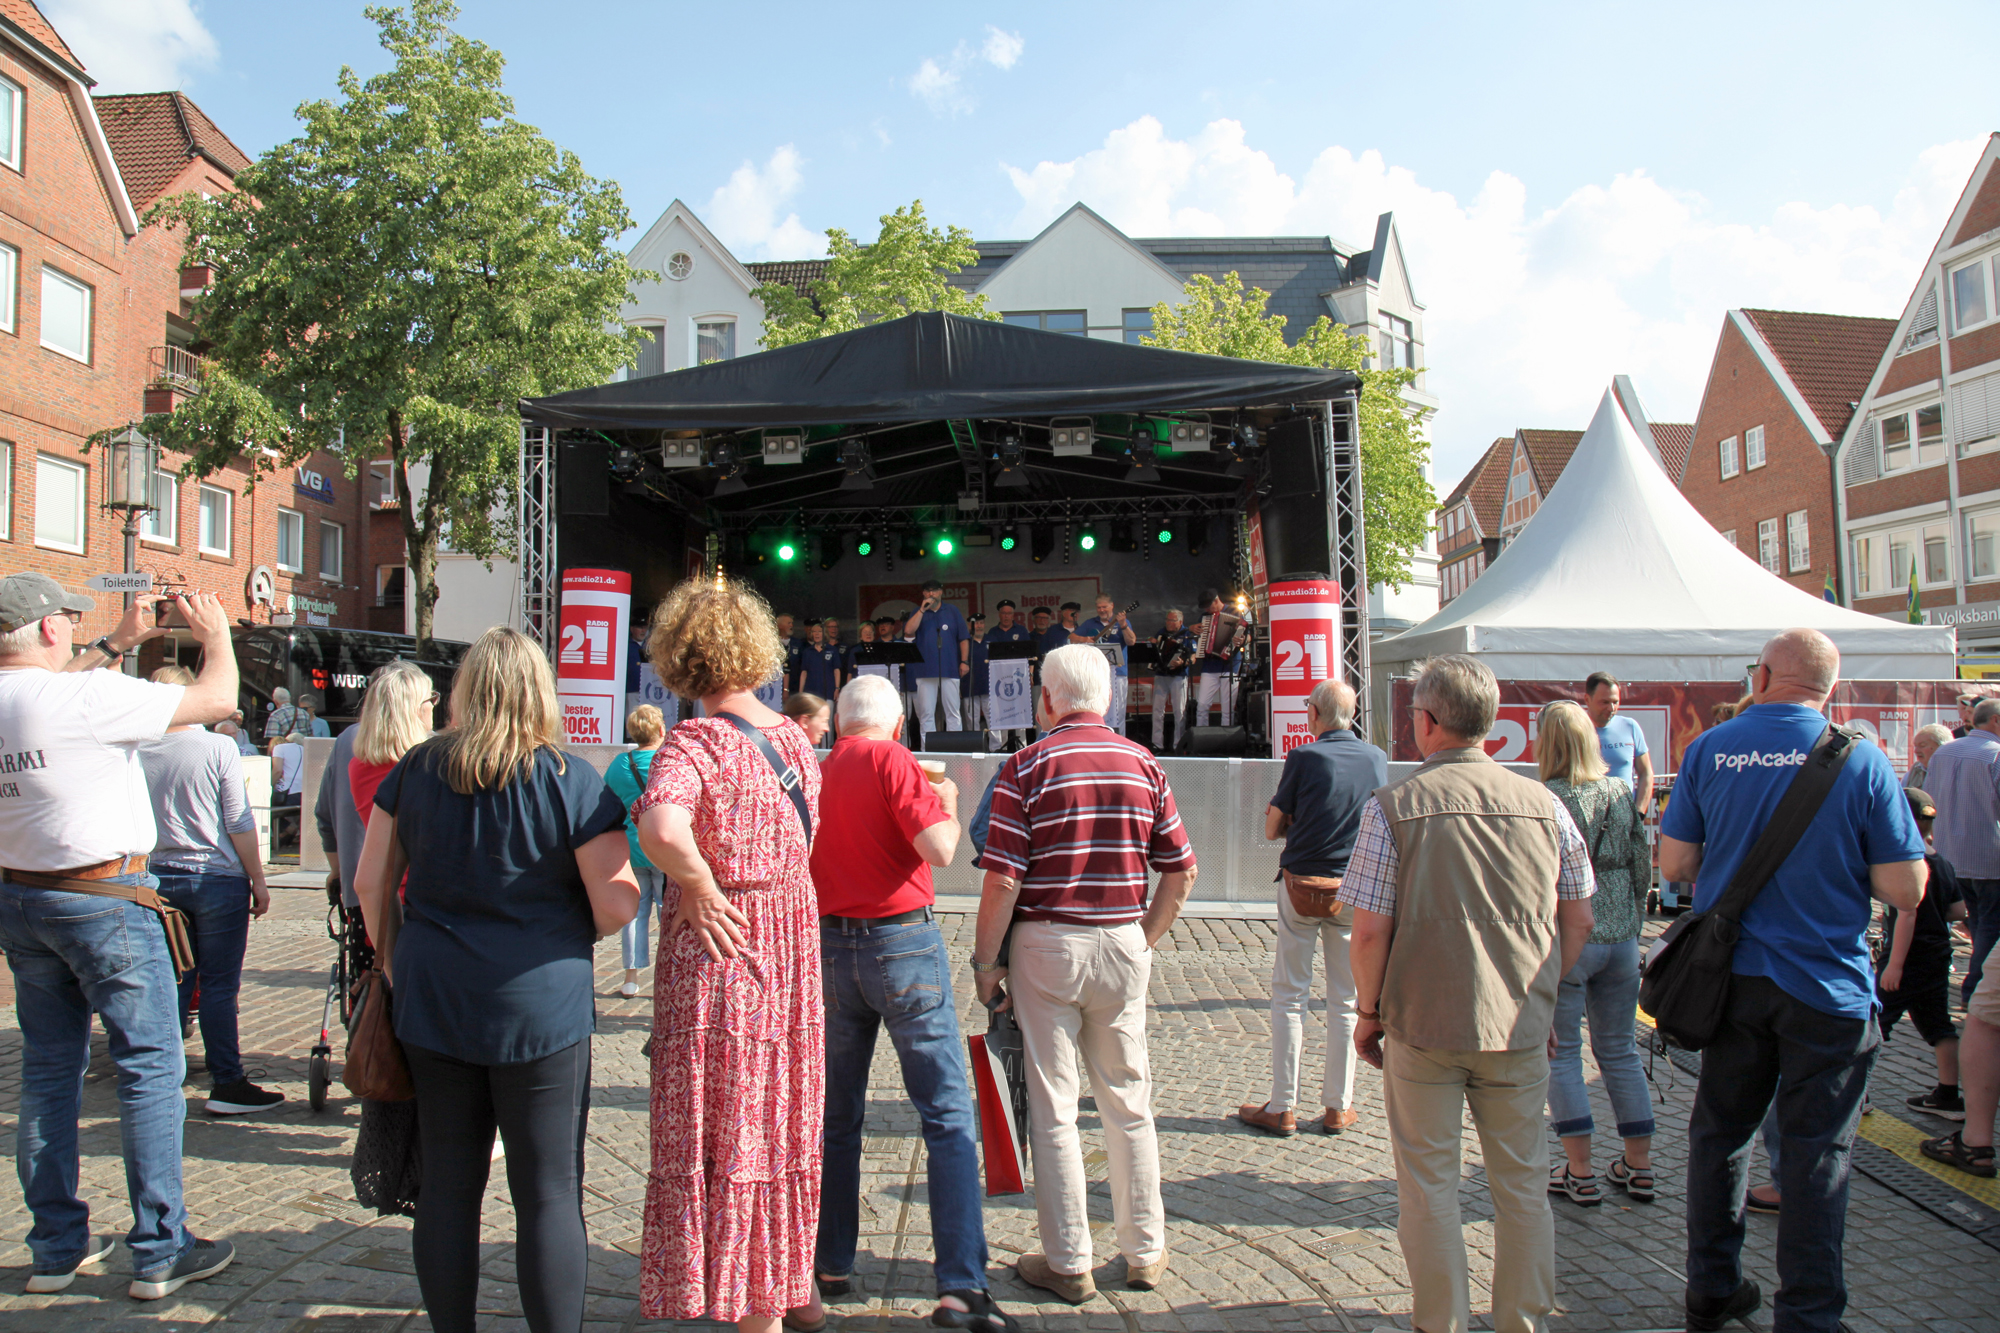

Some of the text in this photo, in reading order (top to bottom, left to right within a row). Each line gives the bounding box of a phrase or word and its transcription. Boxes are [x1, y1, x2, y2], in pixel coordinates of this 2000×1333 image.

[298, 467, 334, 495] VGA
[101, 577, 148, 588] Toiletten
[1270, 587, 1330, 598] www.radio21.de
[1021, 594, 1061, 607] bester
[586, 619, 609, 627] RADIO
[560, 624, 609, 665] 21
[1275, 639, 1328, 680] 21
[564, 704, 594, 715] bester
[1879, 711, 1909, 720] RADIO
